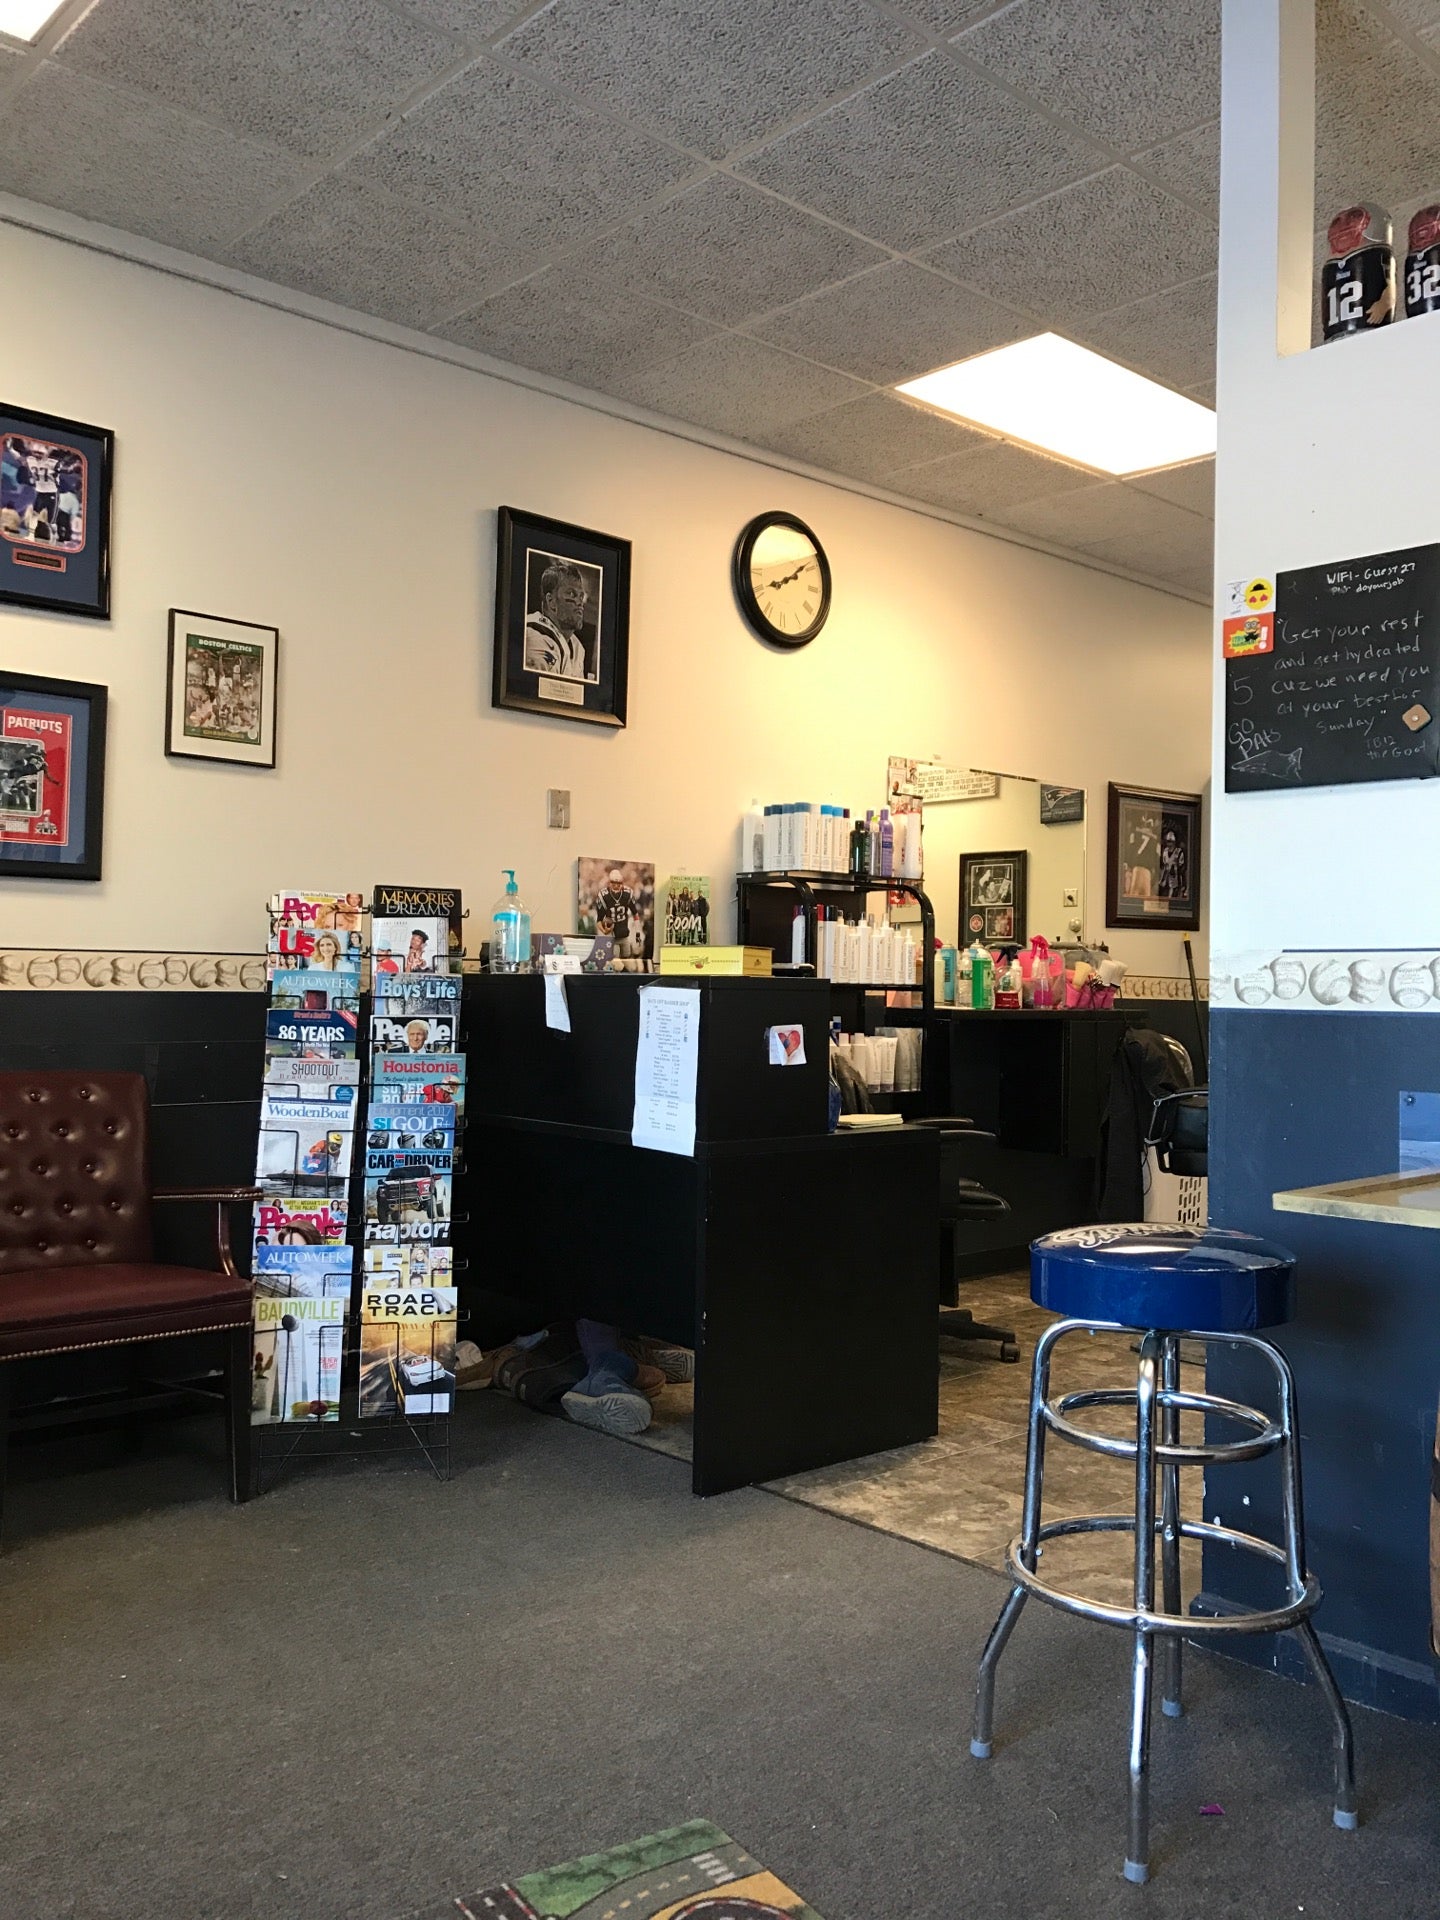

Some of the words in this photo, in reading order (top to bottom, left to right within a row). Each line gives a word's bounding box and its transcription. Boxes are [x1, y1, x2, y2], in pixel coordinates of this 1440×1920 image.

[1407, 264, 1440, 305] 32
[1327, 280, 1363, 327] 12
[1326, 571, 1353, 585] WIFI
[1400, 562, 1416, 574] 27
[1355, 577, 1405, 593] doyourjob
[1327, 624, 1371, 644] your
[1380, 609, 1424, 632] rest
[198, 638, 227, 649] BOSTON
[228, 642, 252, 653] CELTICS
[1274, 651, 1305, 670] and
[1313, 651, 1340, 667] get
[1344, 634, 1421, 664] hydrated
[1271, 680, 1313, 694] cuz
[1315, 676, 1337, 688] we
[1345, 666, 1391, 684] need
[1397, 665, 1431, 684] you
[1232, 675, 1254, 705] 5
[1276, 701, 1293, 715] at
[1301, 699, 1345, 718] your
[7, 715, 63, 734] PATRIOTS
[1228, 718, 1255, 745] GO
[380, 890, 455, 908] MEMORIES
[385, 902, 450, 916] DREAMS
[609, 905, 626, 922] 12
[279, 929, 316, 957] Us
[279, 975, 356, 989] AUTOWEEK
[426, 981, 457, 999] Life
[278, 1025, 297, 1040] 86
[300, 1025, 345, 1041] YEARS
[291, 1063, 341, 1077] SHOOTOUT
[268, 1104, 349, 1120] WoodenBoat
[368, 1154, 395, 1169] CAR
[404, 1154, 451, 1169] DRIVER
[365, 1219, 451, 1244] Raptor!
[265, 1251, 347, 1264] AUTOWEEK
[367, 1293, 435, 1305] ROAD
